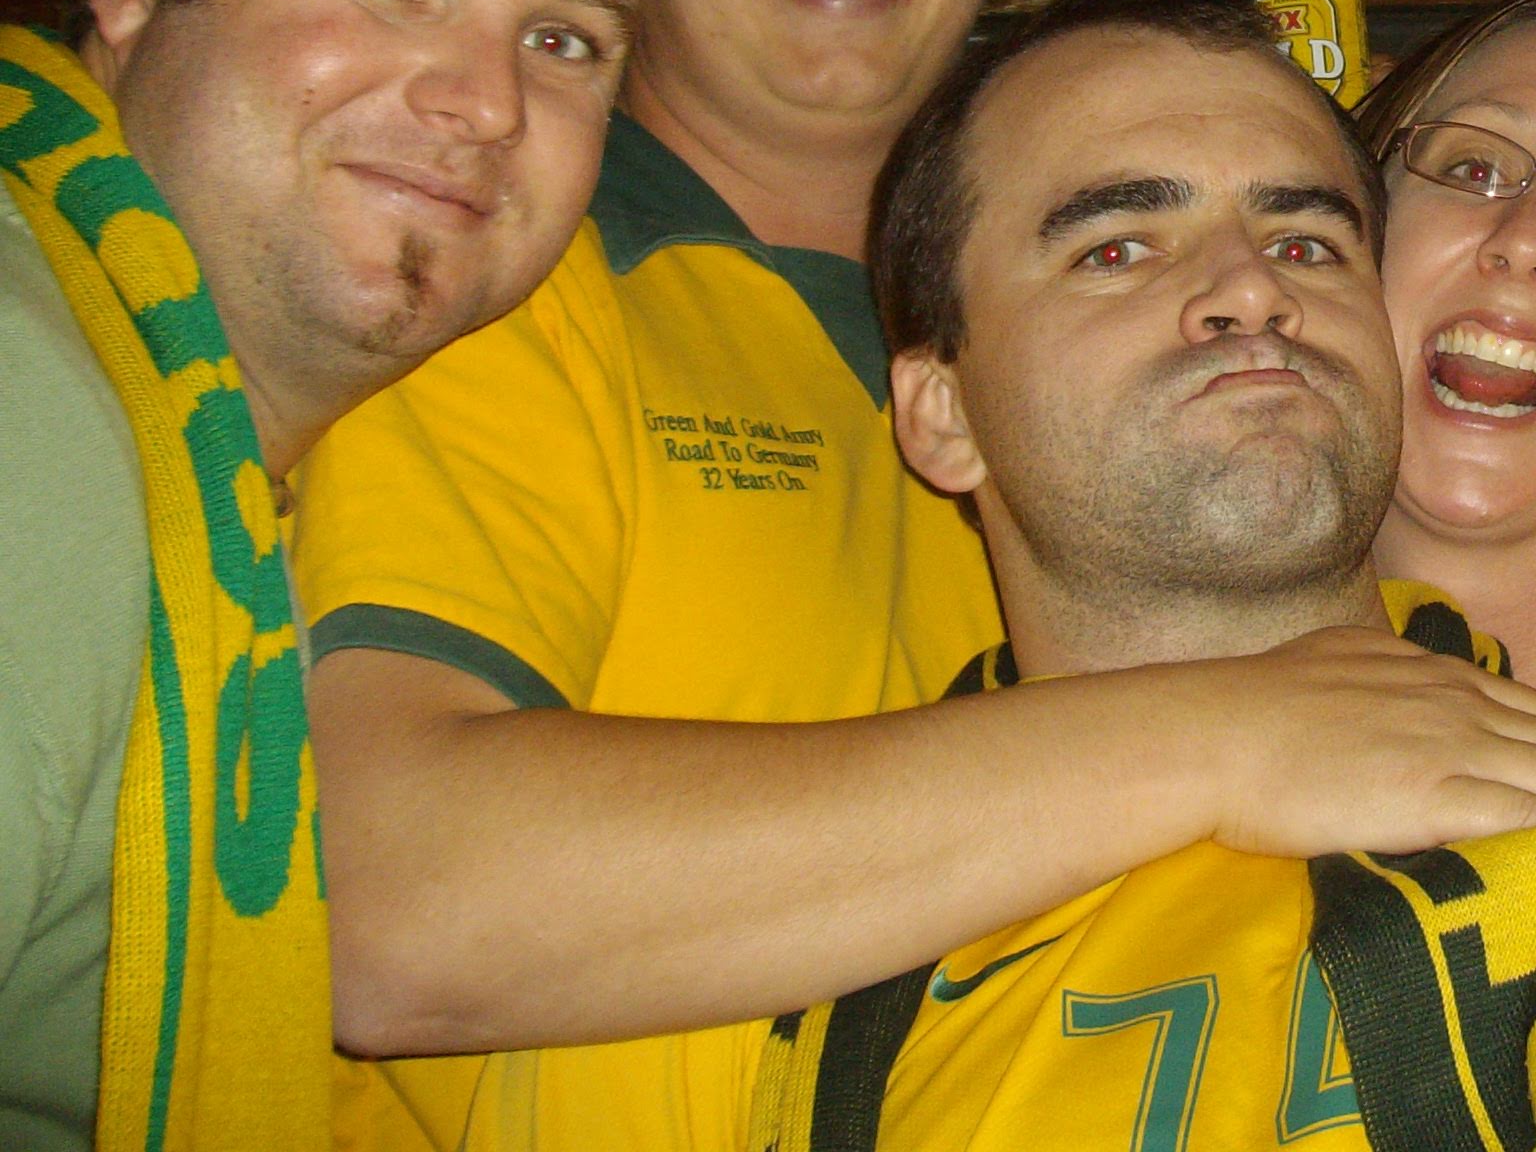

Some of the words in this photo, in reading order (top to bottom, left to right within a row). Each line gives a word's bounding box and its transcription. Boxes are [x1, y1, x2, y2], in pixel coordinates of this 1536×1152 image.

[643, 407, 698, 432] Green
[704, 413, 738, 437] And
[740, 417, 780, 441] Gold
[782, 426, 824, 446] Army
[664, 439, 716, 462] Road
[719, 441, 742, 463] To
[747, 444, 820, 471] Germany
[700, 468, 724, 490] 32
[727, 469, 775, 490] Years
[777, 470, 807, 491] On
